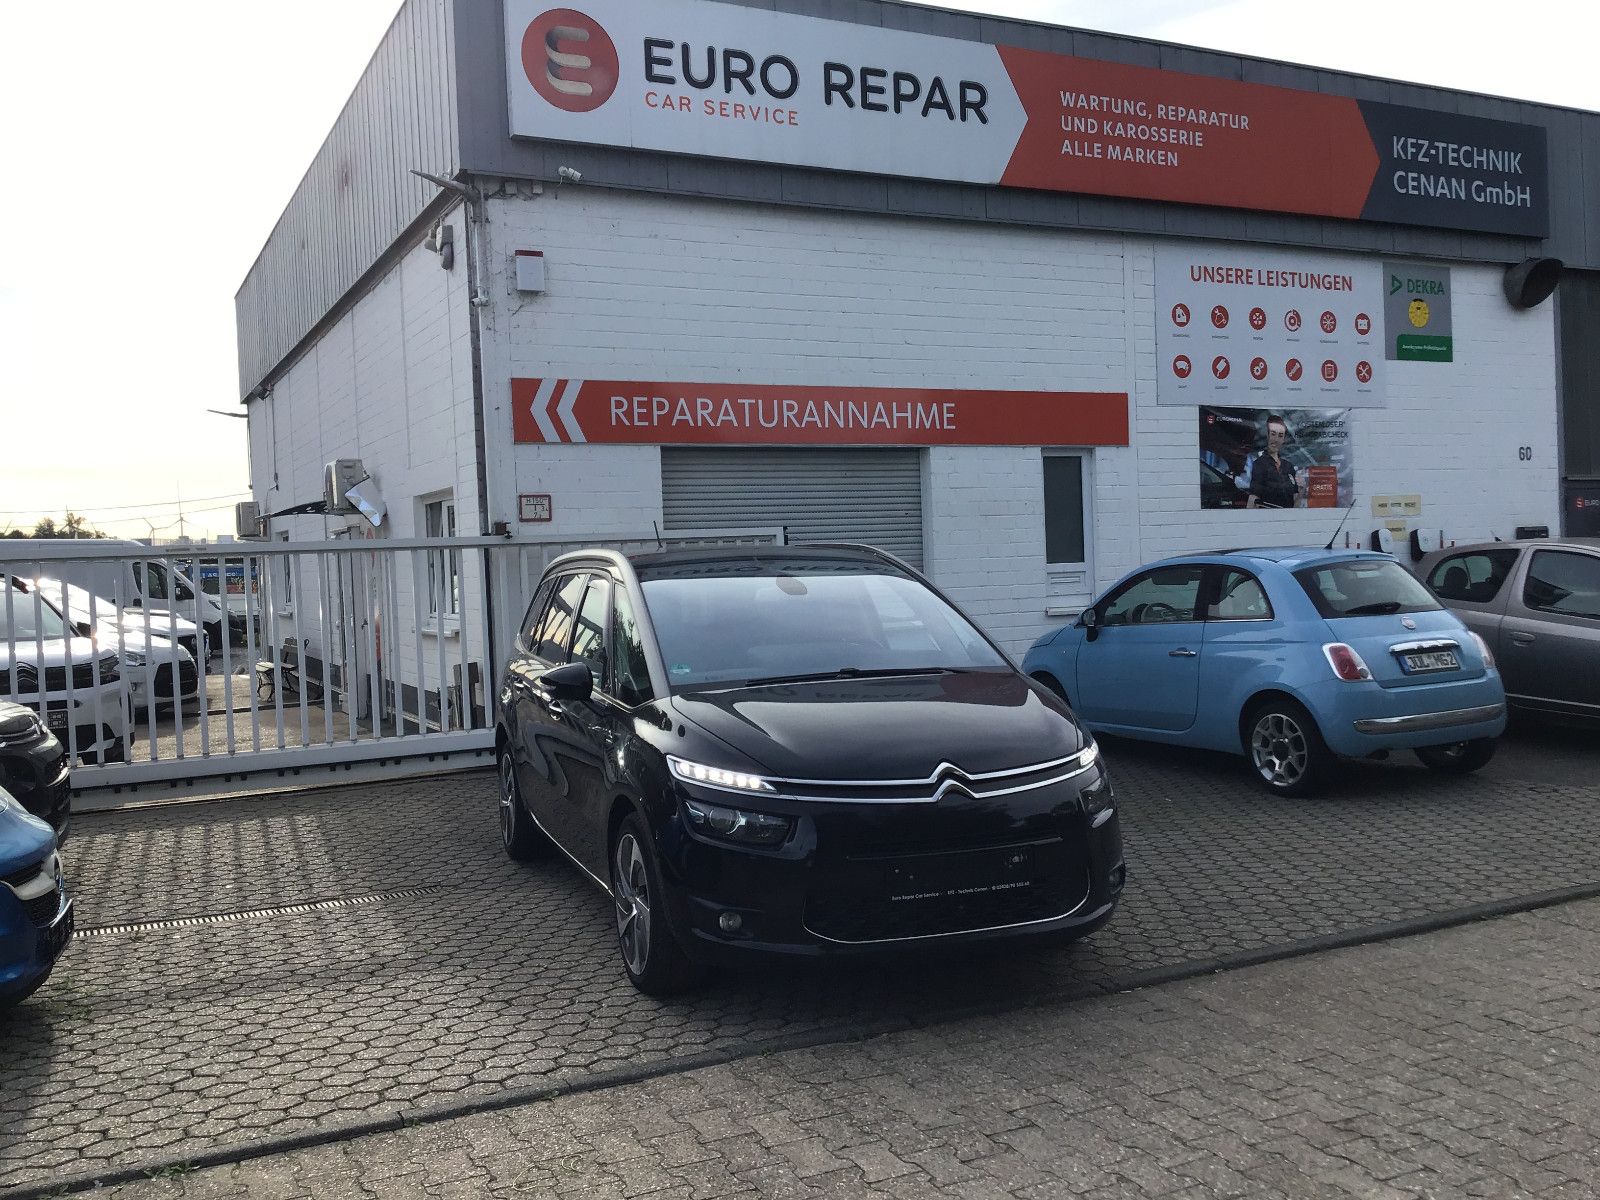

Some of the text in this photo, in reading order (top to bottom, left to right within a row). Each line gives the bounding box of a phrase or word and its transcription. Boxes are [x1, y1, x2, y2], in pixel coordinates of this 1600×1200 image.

[643, 37, 989, 125] EURO REPAR
[644, 91, 799, 126] CAR SERVICE
[1060, 90, 1250, 130] WARTUNG, REPARATUR
[1061, 115, 1204, 148] UND KAROSSERIE
[1061, 139, 1179, 167] ALLE MARKEN
[1392, 136, 1523, 174] KFZ-TECHNIK
[1393, 170, 1532, 208] CENAN GmbH
[1190, 264, 1353, 292] UNSERE LEISTUNGEN
[1406, 278, 1446, 297] DEKRA
[610, 395, 957, 431] REPARATURANNAHME
[1518, 446, 1532, 461] 60
